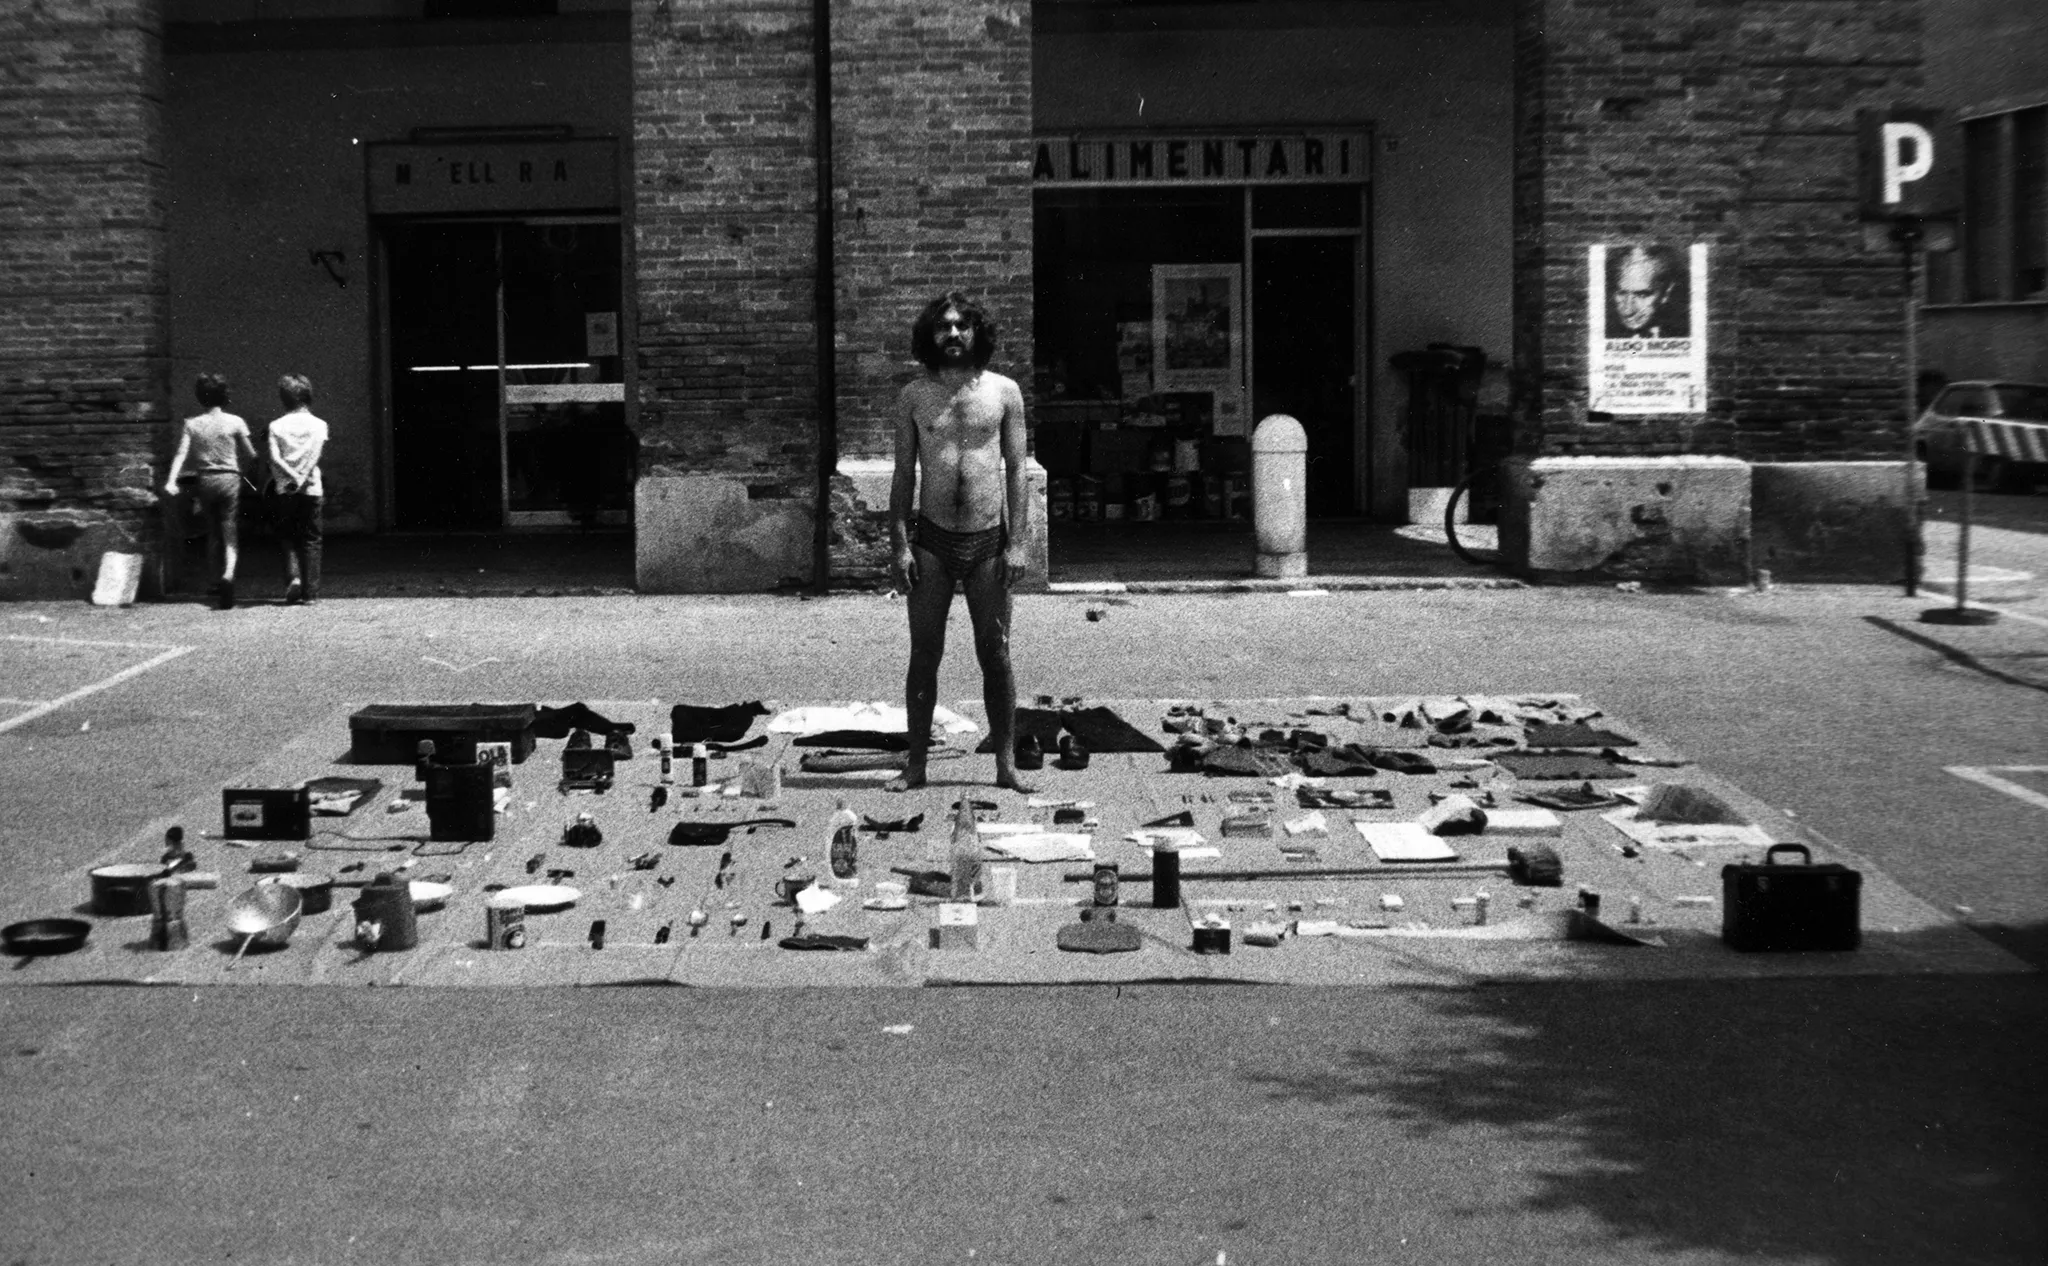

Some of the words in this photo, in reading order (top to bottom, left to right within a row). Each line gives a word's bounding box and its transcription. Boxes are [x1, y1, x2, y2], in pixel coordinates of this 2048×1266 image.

[1033, 139, 1350, 180] ALIMENTARI
[1882, 122, 1934, 204] P
[1605, 341, 1643, 351] ALDO
[1646, 340, 1692, 350] MORO
